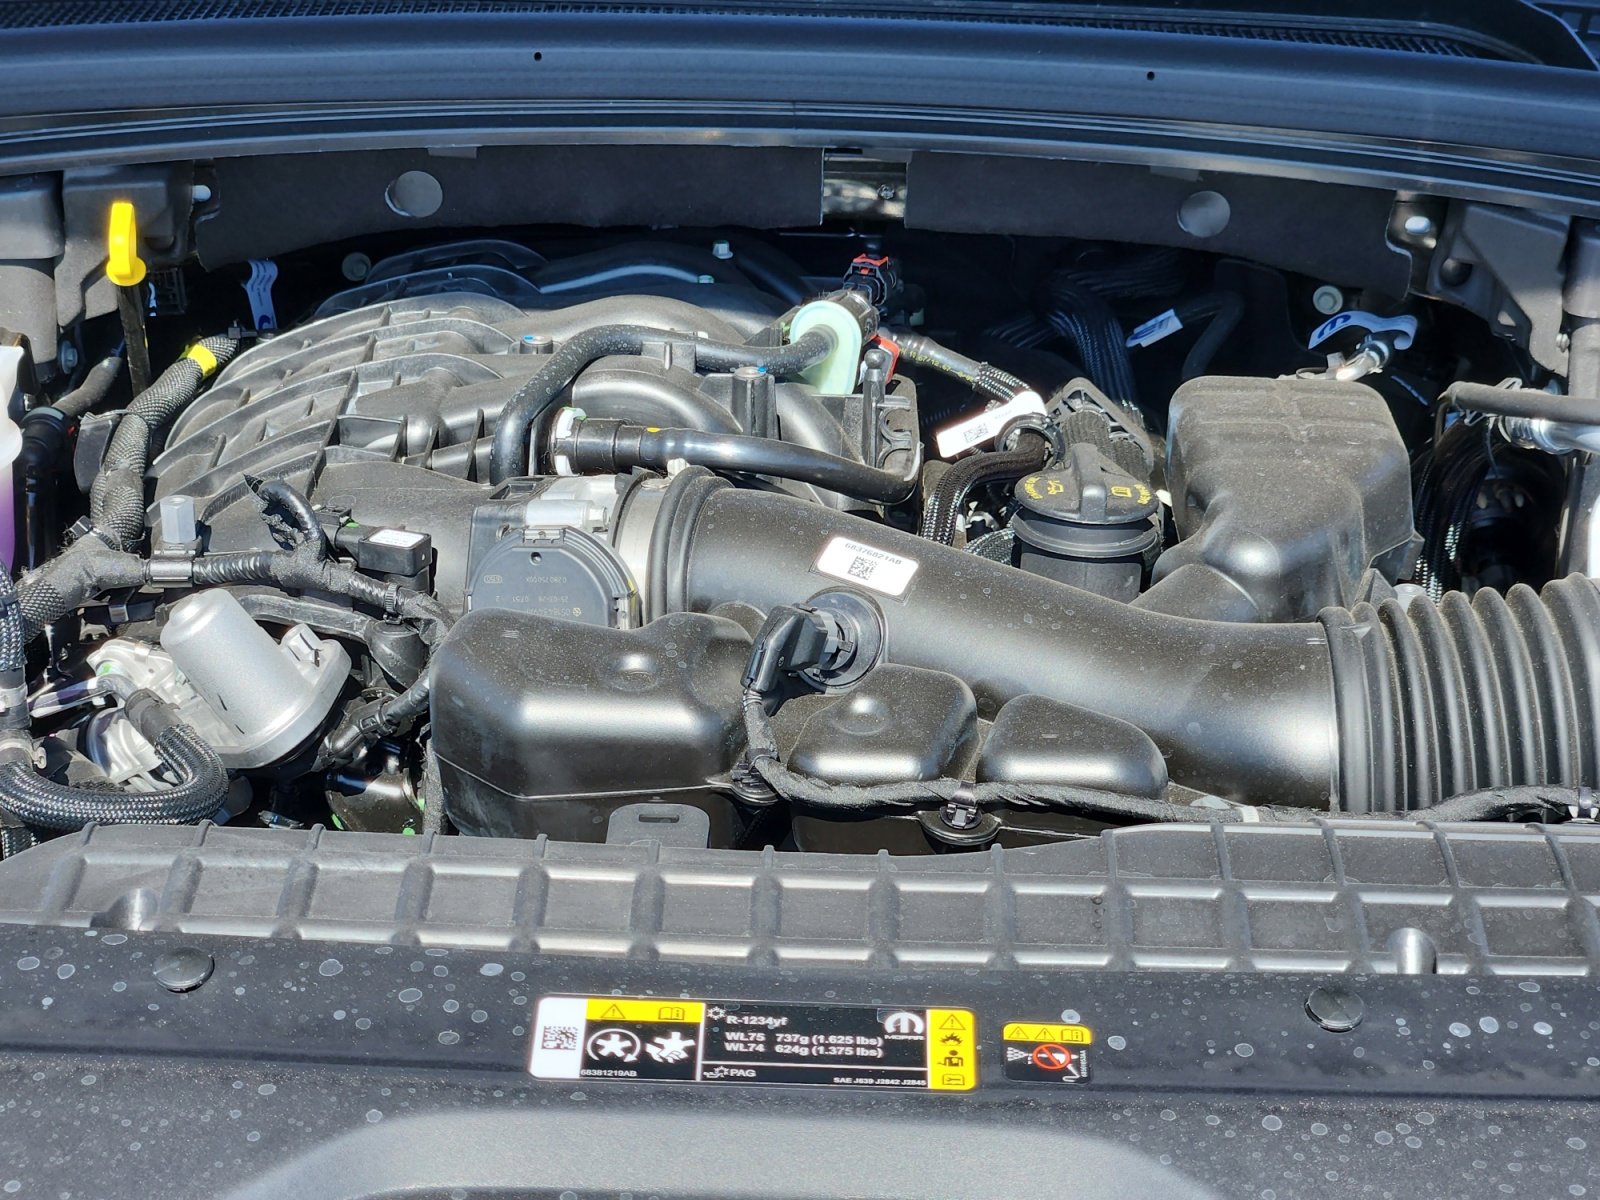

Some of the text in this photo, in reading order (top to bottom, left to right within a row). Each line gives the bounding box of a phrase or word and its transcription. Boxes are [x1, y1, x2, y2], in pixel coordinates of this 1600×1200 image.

[726, 1015, 788, 1028] R-1234yf
[724, 1031, 884, 1047] WL75 737g (1.625 lbs)
[723, 1041, 884, 1058] WL74 624g (1.375 lbs)
[580, 1069, 638, 1077] 68381219AB
[730, 1068, 757, 1078] PAG
